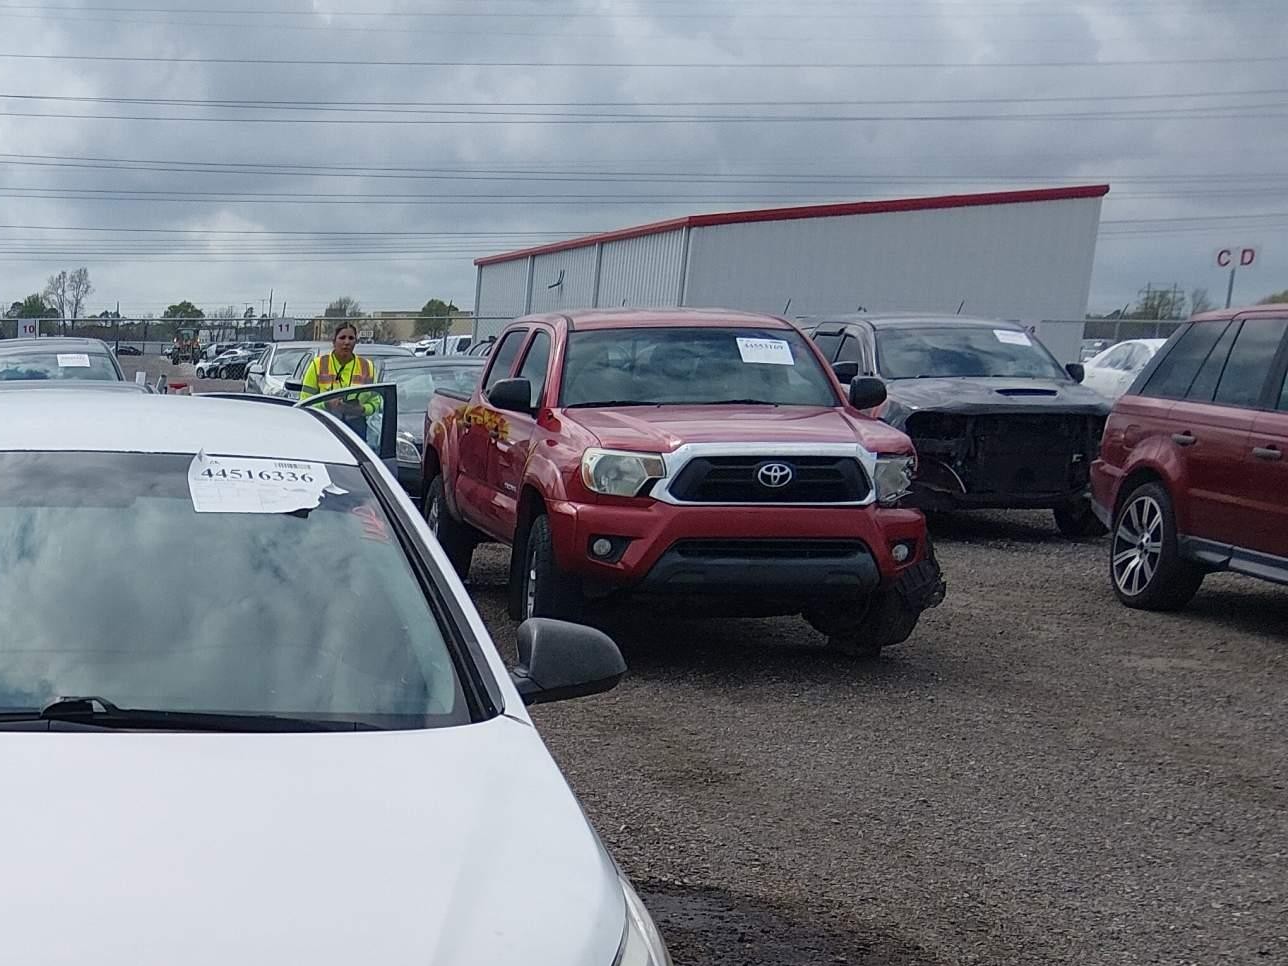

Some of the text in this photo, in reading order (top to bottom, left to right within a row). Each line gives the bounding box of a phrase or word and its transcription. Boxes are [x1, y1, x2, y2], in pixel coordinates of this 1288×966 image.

[1217, 249, 1255, 267] C D
[23, 325, 35, 333] 10
[278, 324, 289, 332] 11
[201, 468, 314, 483] 44516336
